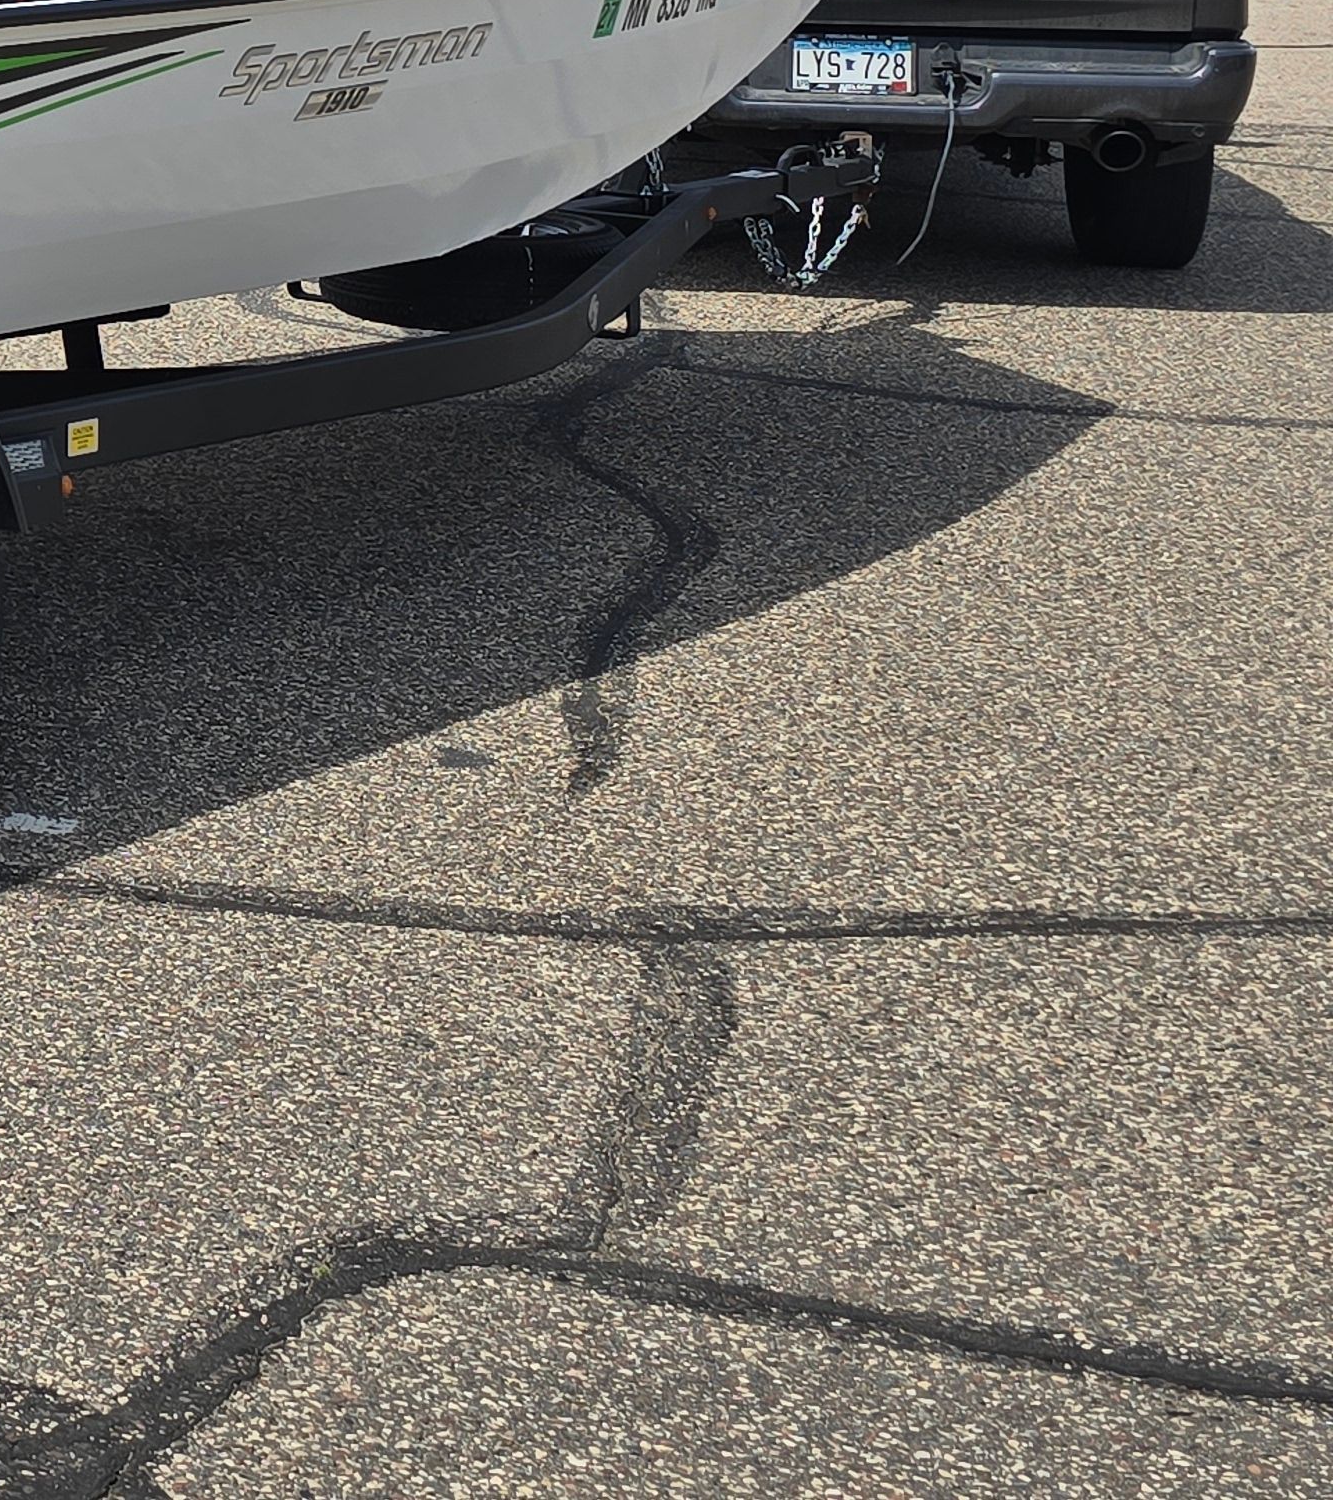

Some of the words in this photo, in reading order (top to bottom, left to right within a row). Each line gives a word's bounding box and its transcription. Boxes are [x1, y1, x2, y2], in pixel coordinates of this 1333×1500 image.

[595, 0, 621, 31] 27
[219, 22, 493, 106] Sportsman
[796, 50, 841, 78] LYS
[861, 52, 906, 80] 728
[316, 87, 370, 116] 1910
